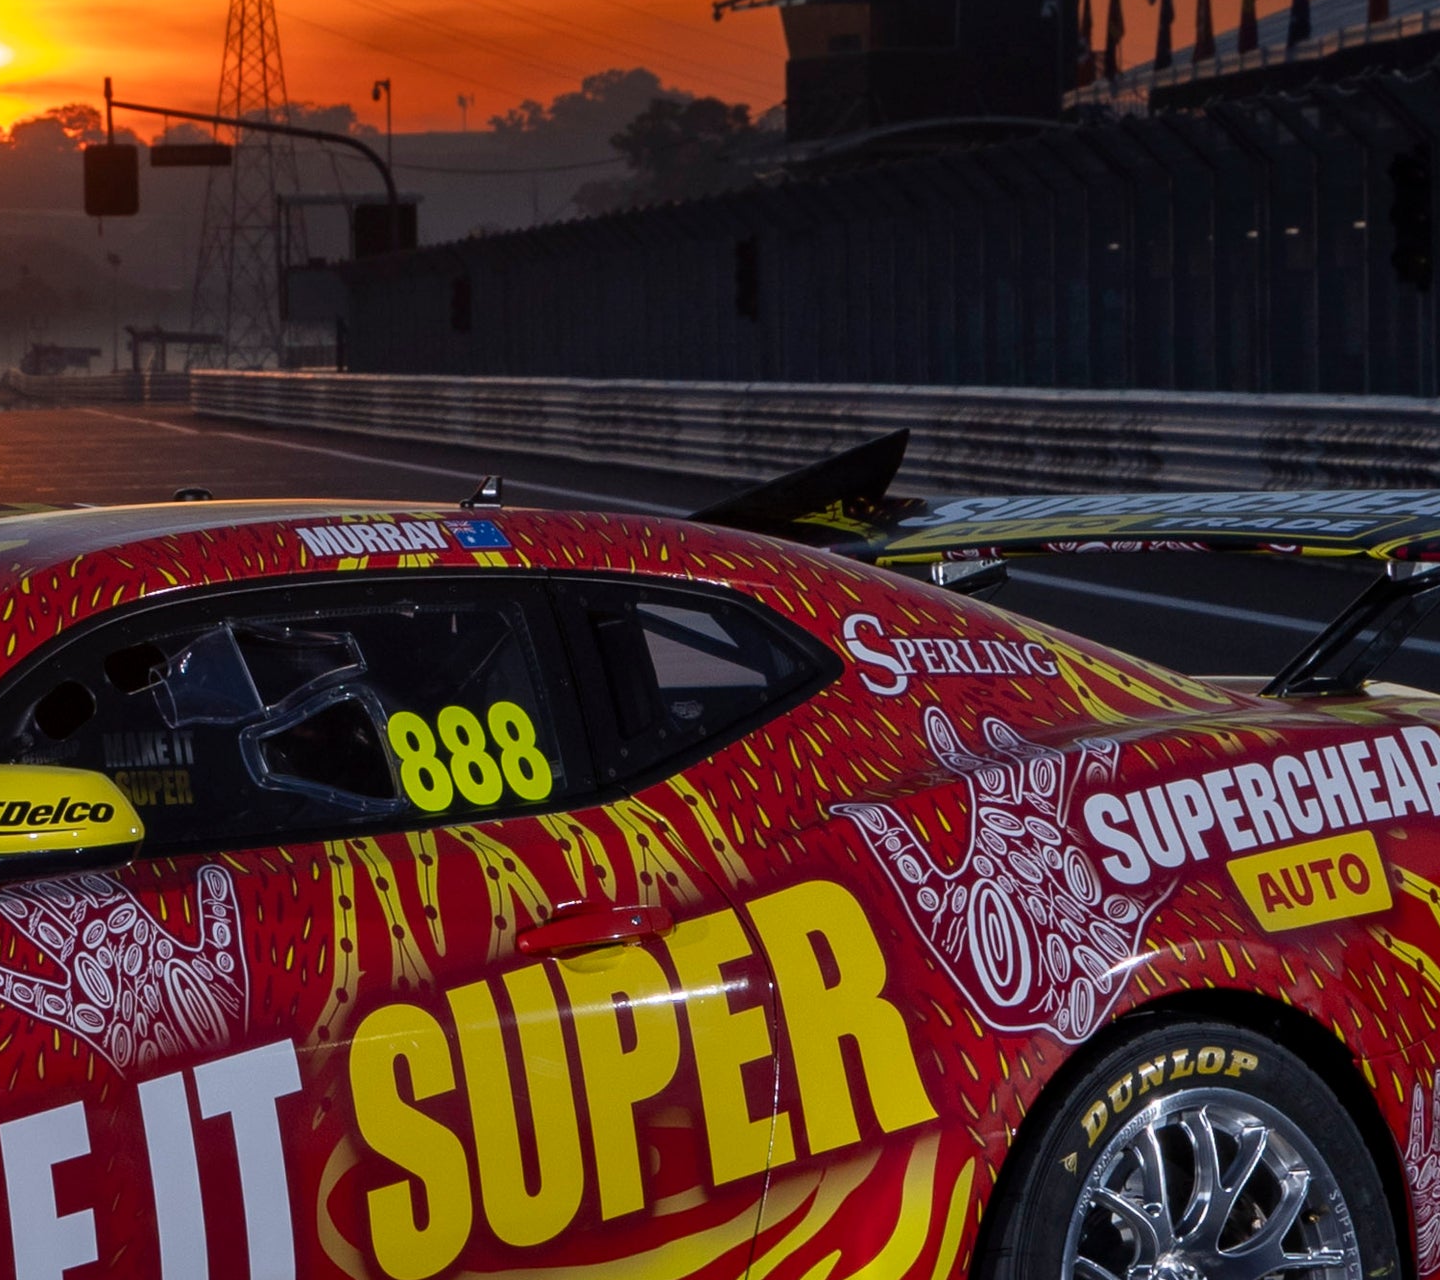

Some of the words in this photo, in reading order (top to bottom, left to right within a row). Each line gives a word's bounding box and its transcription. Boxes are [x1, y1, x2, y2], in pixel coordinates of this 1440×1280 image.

[296, 519, 453, 558] MURRAY
[1152, 516, 1381, 533] TRADE
[841, 612, 1058, 697] SPERLING
[387, 699, 552, 812] 888
[1257, 852, 1371, 912] AUTO
[1080, 1046, 1259, 1148] DUNLOP
